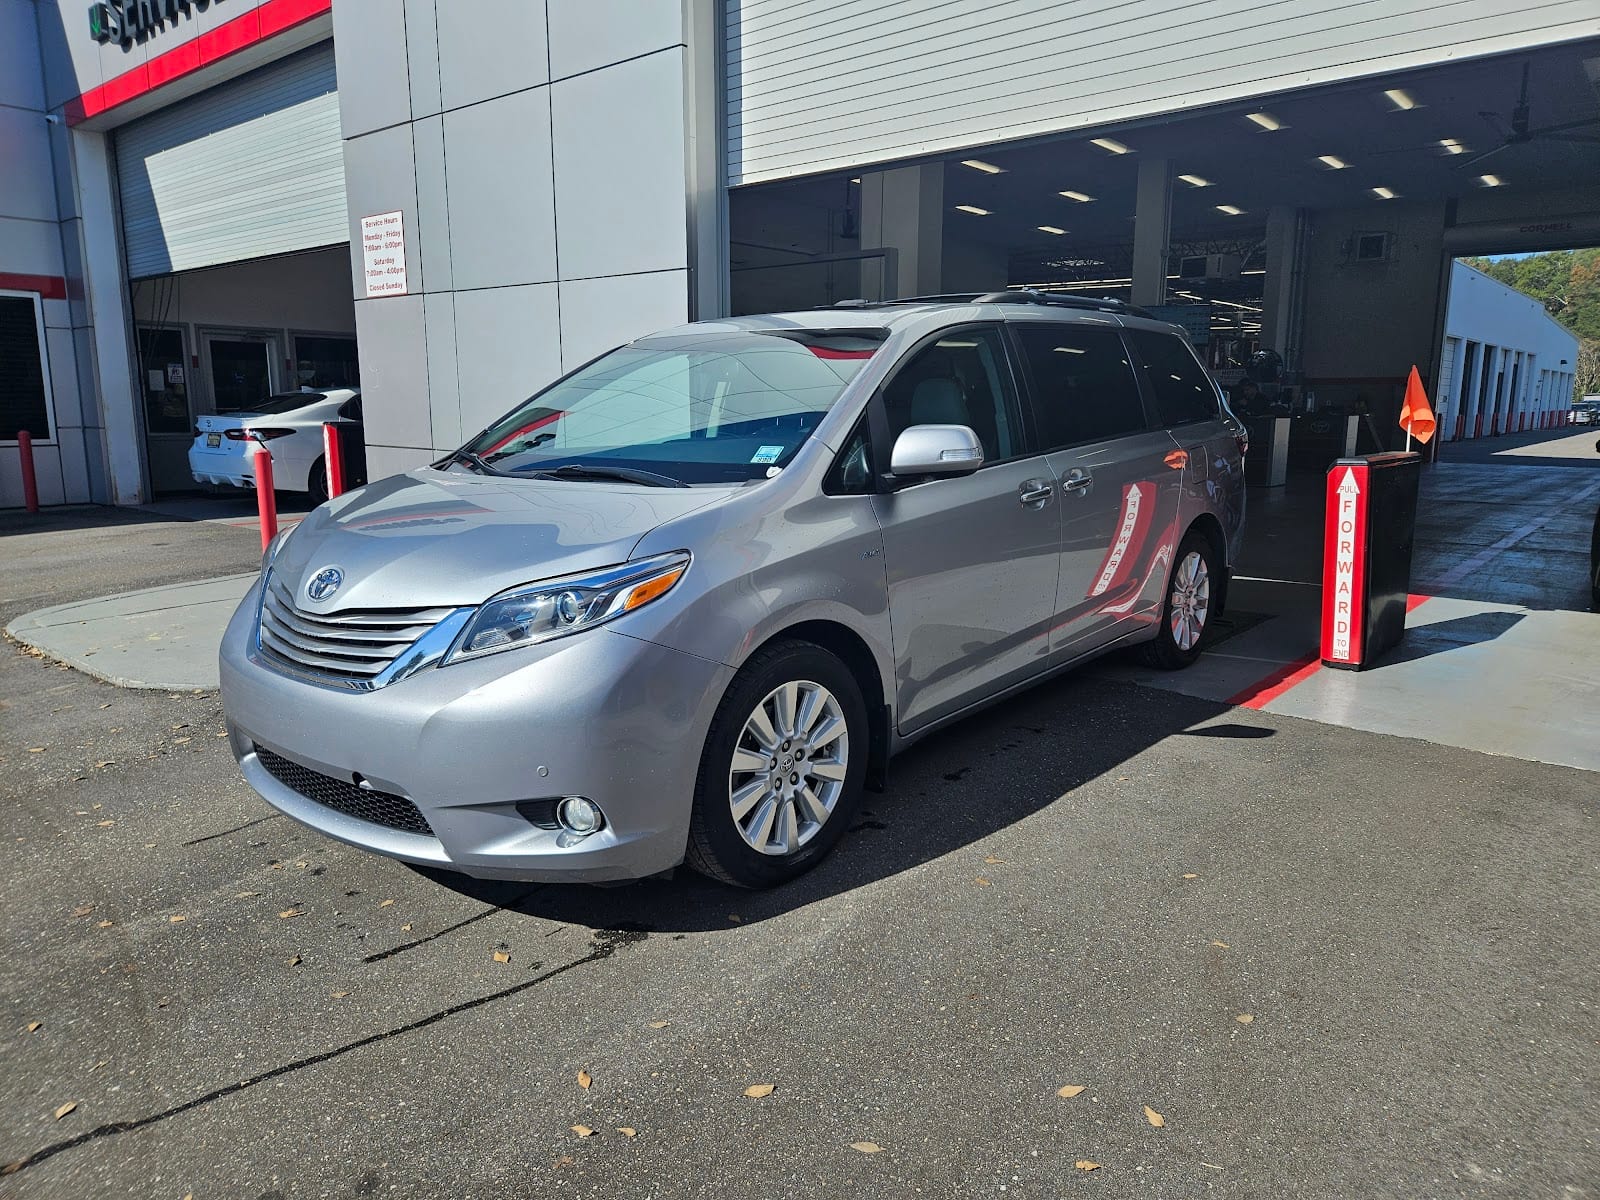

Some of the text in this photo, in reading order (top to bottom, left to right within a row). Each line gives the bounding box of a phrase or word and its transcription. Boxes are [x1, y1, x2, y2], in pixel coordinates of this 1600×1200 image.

[366, 220, 383, 228] Service
[365, 233, 382, 241] Monday
[386, 230, 400, 238] Friday
[374, 258, 395, 266] Saturday
[386, 282, 402, 290] Sunday
[1340, 485, 1358, 494] PULL
[1337, 500, 1352, 634] FORWARD
[1336, 639, 1347, 647] TO
[1333, 649, 1349, 658] END
